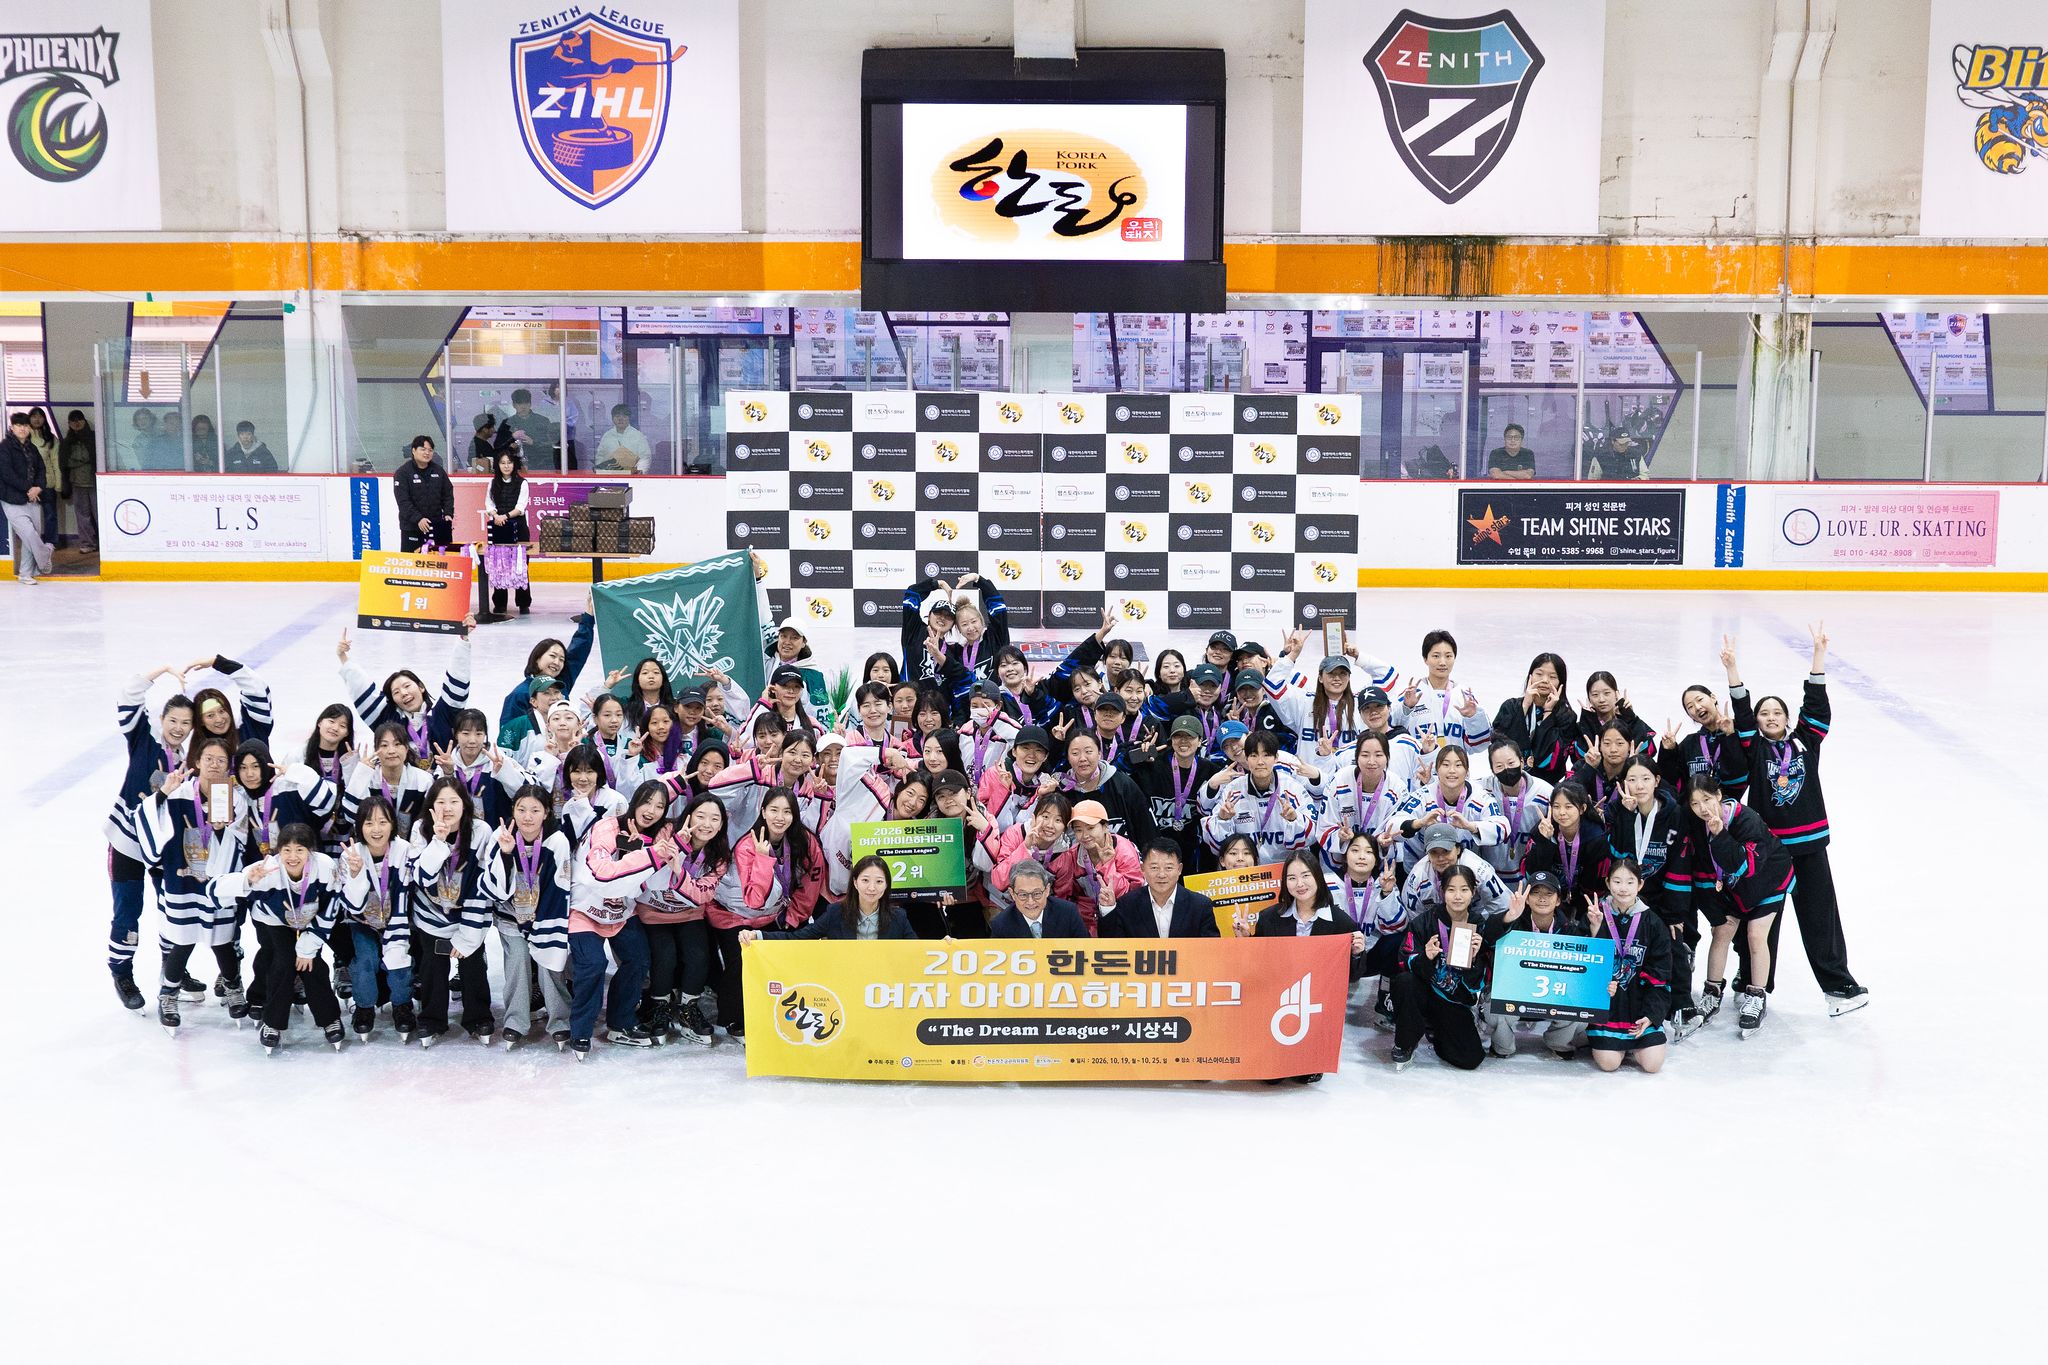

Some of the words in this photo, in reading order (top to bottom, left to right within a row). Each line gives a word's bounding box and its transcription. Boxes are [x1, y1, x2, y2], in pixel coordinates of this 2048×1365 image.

[519, 5, 582, 34] ZENITH
[599, 5, 664, 35] LEAGUE
[0, 33, 114, 81] PHOENIX
[1395, 48, 1513, 69] ZENITH
[531, 87, 653, 118] ZIHL
[1056, 150, 1107, 160] KOREA
[1056, 161, 1098, 170] PORK
[360, 481, 370, 516] Zenith
[1725, 488, 1737, 523] Zenith
[1565, 502, 1581, 512] 피겨
[1584, 502, 1600, 511] 성인
[1602, 502, 1627, 511] 전문반
[1841, 505, 1856, 513] 피겨
[1864, 505, 1879, 513] 발레
[1881, 505, 1897, 514] 의상
[1899, 505, 1914, 514] 대여
[1952, 505, 1975, 514] 브랜드
[1521, 518, 1564, 536] TEAM
[1569, 518, 1618, 536] SHINE
[1624, 518, 1670, 536] STARS
[361, 521, 372, 550] Zenit
[1508, 547, 1521, 556] 수업
[1523, 547, 1536, 556] 문의
[1725, 528, 1737, 564] Zenith
[384, 557, 412, 566] 2026
[415, 560, 448, 570] 한돈배
[1214, 633, 1232, 642] NYC
[1263, 715, 1275, 730] C
[874, 827, 902, 836] 2026
[904, 825, 937, 835] 한돈배
[1208, 876, 1237, 887] 2026
[1239, 871, 1272, 883] 한돈배
[1218, 879, 1280, 895] 아이스하키리
[1486, 875, 1504, 898] 17
[1520, 938, 1551, 948] 2026
[1553, 942, 1588, 953] 한돈배
[924, 950, 1037, 976] 2026
[1046, 950, 1177, 976] 한돈배
[1529, 950, 1604, 964] 아이스하키리그
[864, 982, 951, 1008] 여자
[960, 981, 1242, 1008] 아이스하키리그
[979, 1025, 1039, 1037] Dream
[1125, 1022, 1178, 1039] 시상식
